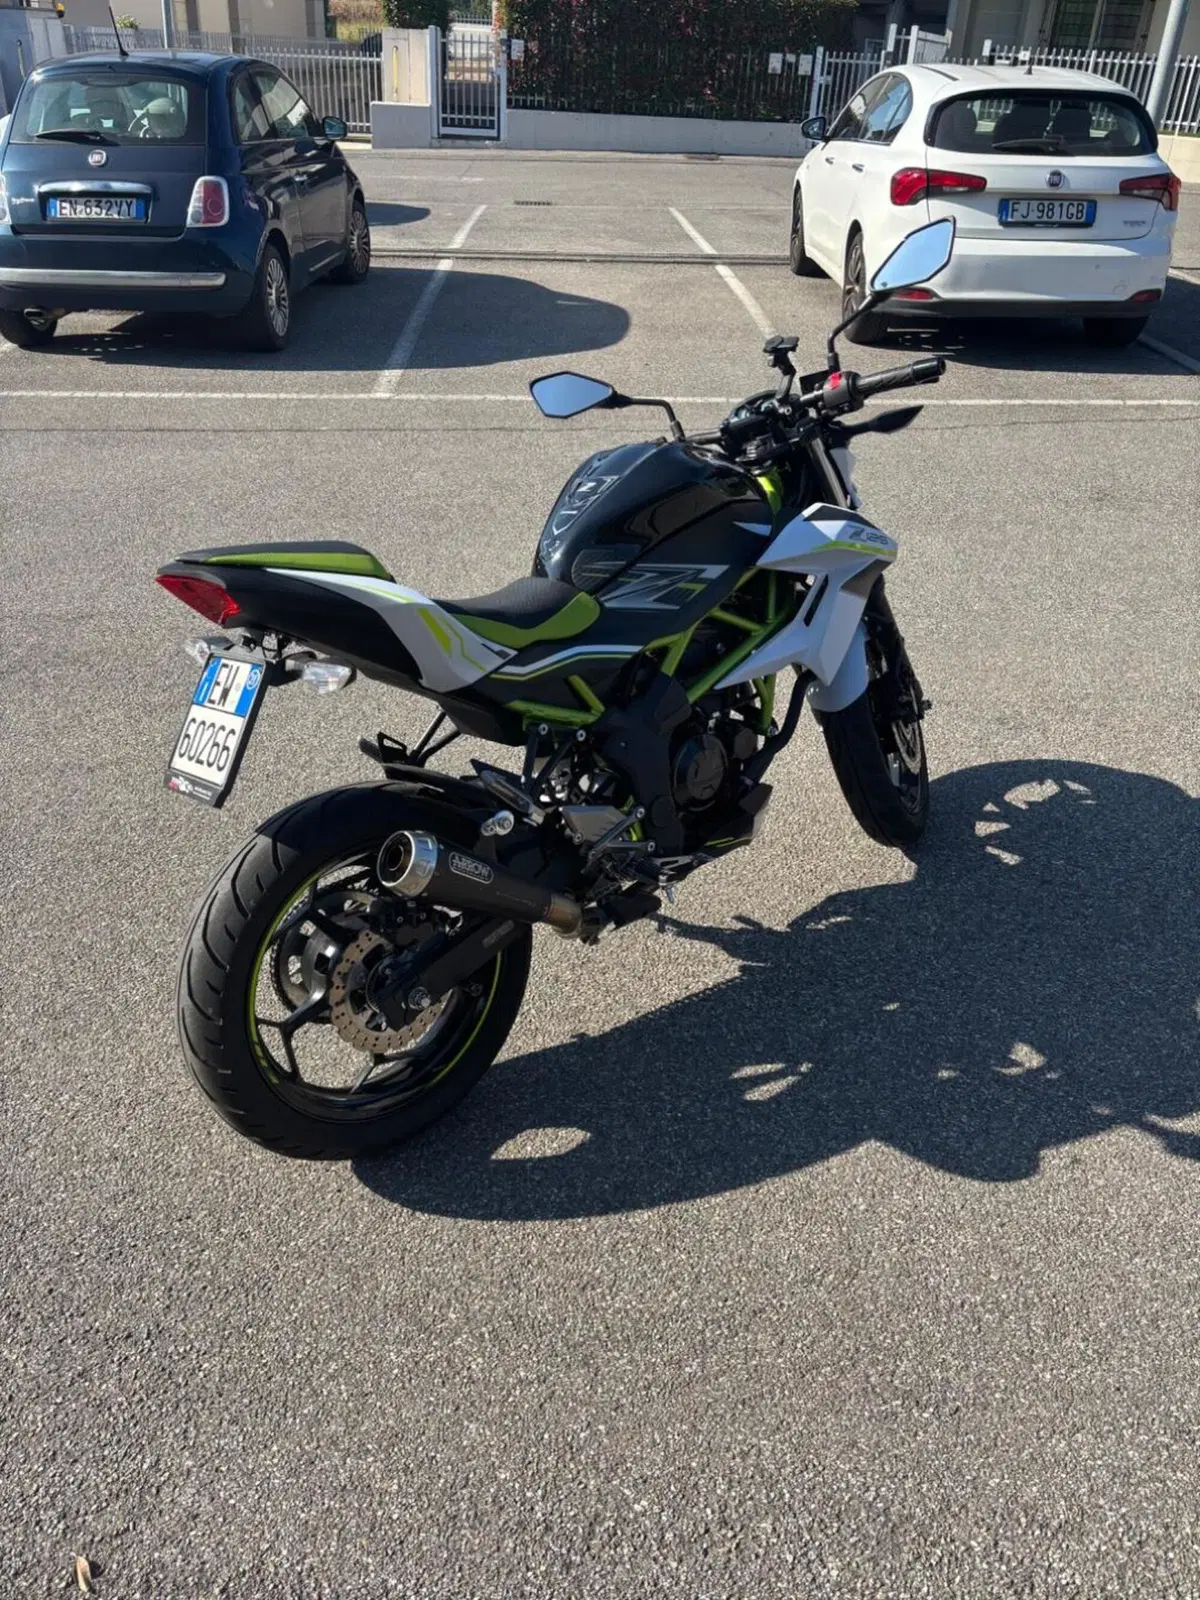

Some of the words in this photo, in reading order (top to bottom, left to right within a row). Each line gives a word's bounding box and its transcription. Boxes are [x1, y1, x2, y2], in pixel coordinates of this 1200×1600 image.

[59, 199, 77, 216] EN
[1010, 201, 1031, 219] FJ
[1036, 202, 1085, 220] 981GB
[207, 662, 240, 707] EW
[178, 717, 236, 772] 60266
[451, 855, 490, 878] ARROW
